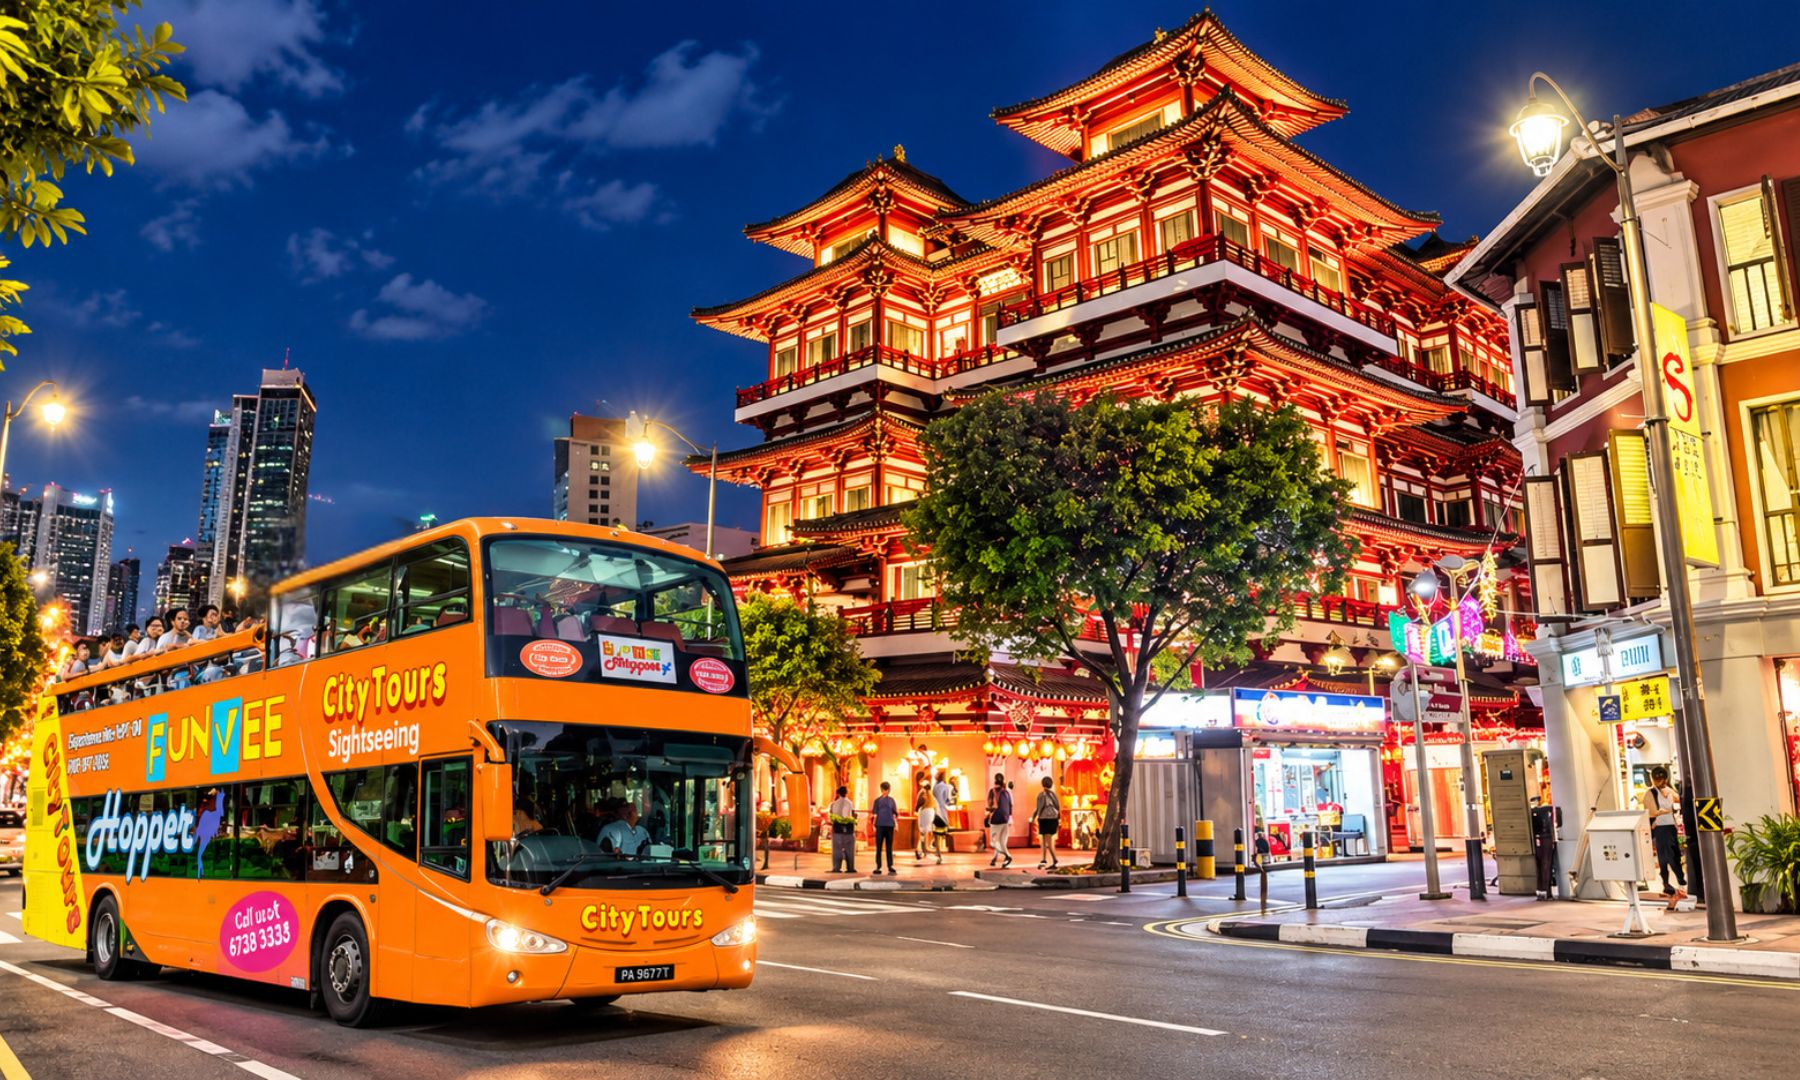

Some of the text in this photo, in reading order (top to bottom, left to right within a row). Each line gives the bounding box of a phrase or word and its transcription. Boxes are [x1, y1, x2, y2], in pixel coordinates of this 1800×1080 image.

[148, 695, 286, 776] FUNVEE
[328, 720, 419, 764] Sightseeing
[86, 788, 195, 885] Hopper
[229, 932, 257, 956] 6738
[621, 967, 669, 981] PA 9677T
